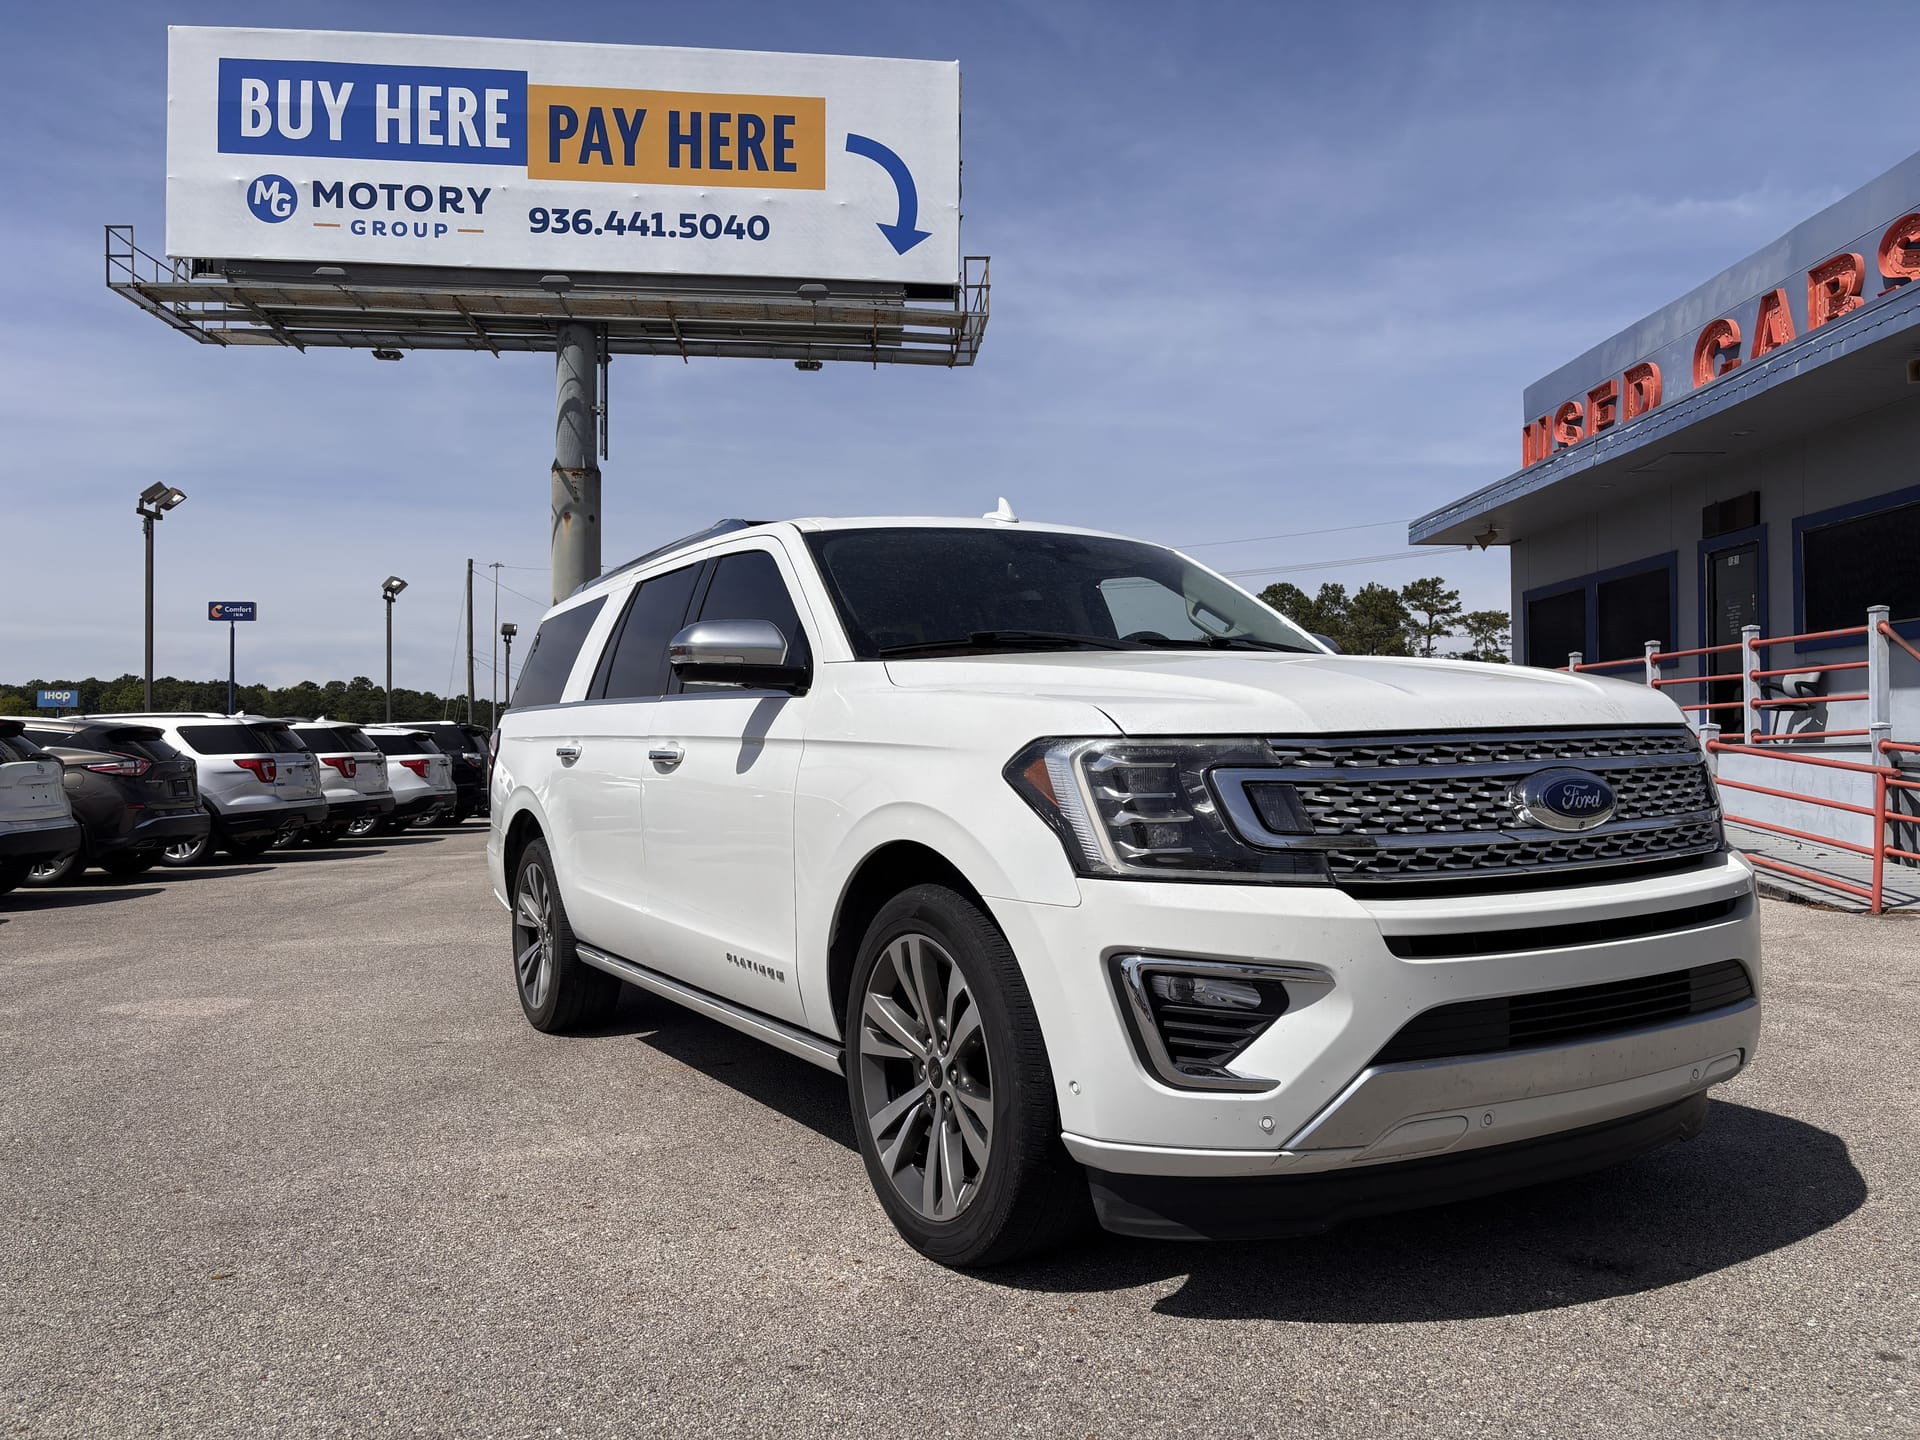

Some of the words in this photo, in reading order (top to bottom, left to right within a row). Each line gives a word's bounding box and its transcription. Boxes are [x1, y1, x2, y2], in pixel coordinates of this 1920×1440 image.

[241, 78, 354, 141] BUY
[375, 83, 511, 149] HERE
[548, 104, 648, 167] PAY
[668, 110, 798, 173] HERE
[254, 180, 292, 218] MG
[312, 180, 492, 215] MOTORY
[350, 219, 449, 239] GROUP
[528, 206, 771, 242] 936.441.5040
[1522, 361, 1663, 469] USED
[1692, 212, 1920, 390] CARS
[1562, 784, 1601, 809] Ford
[726, 952, 785, 984] PLATINUM
